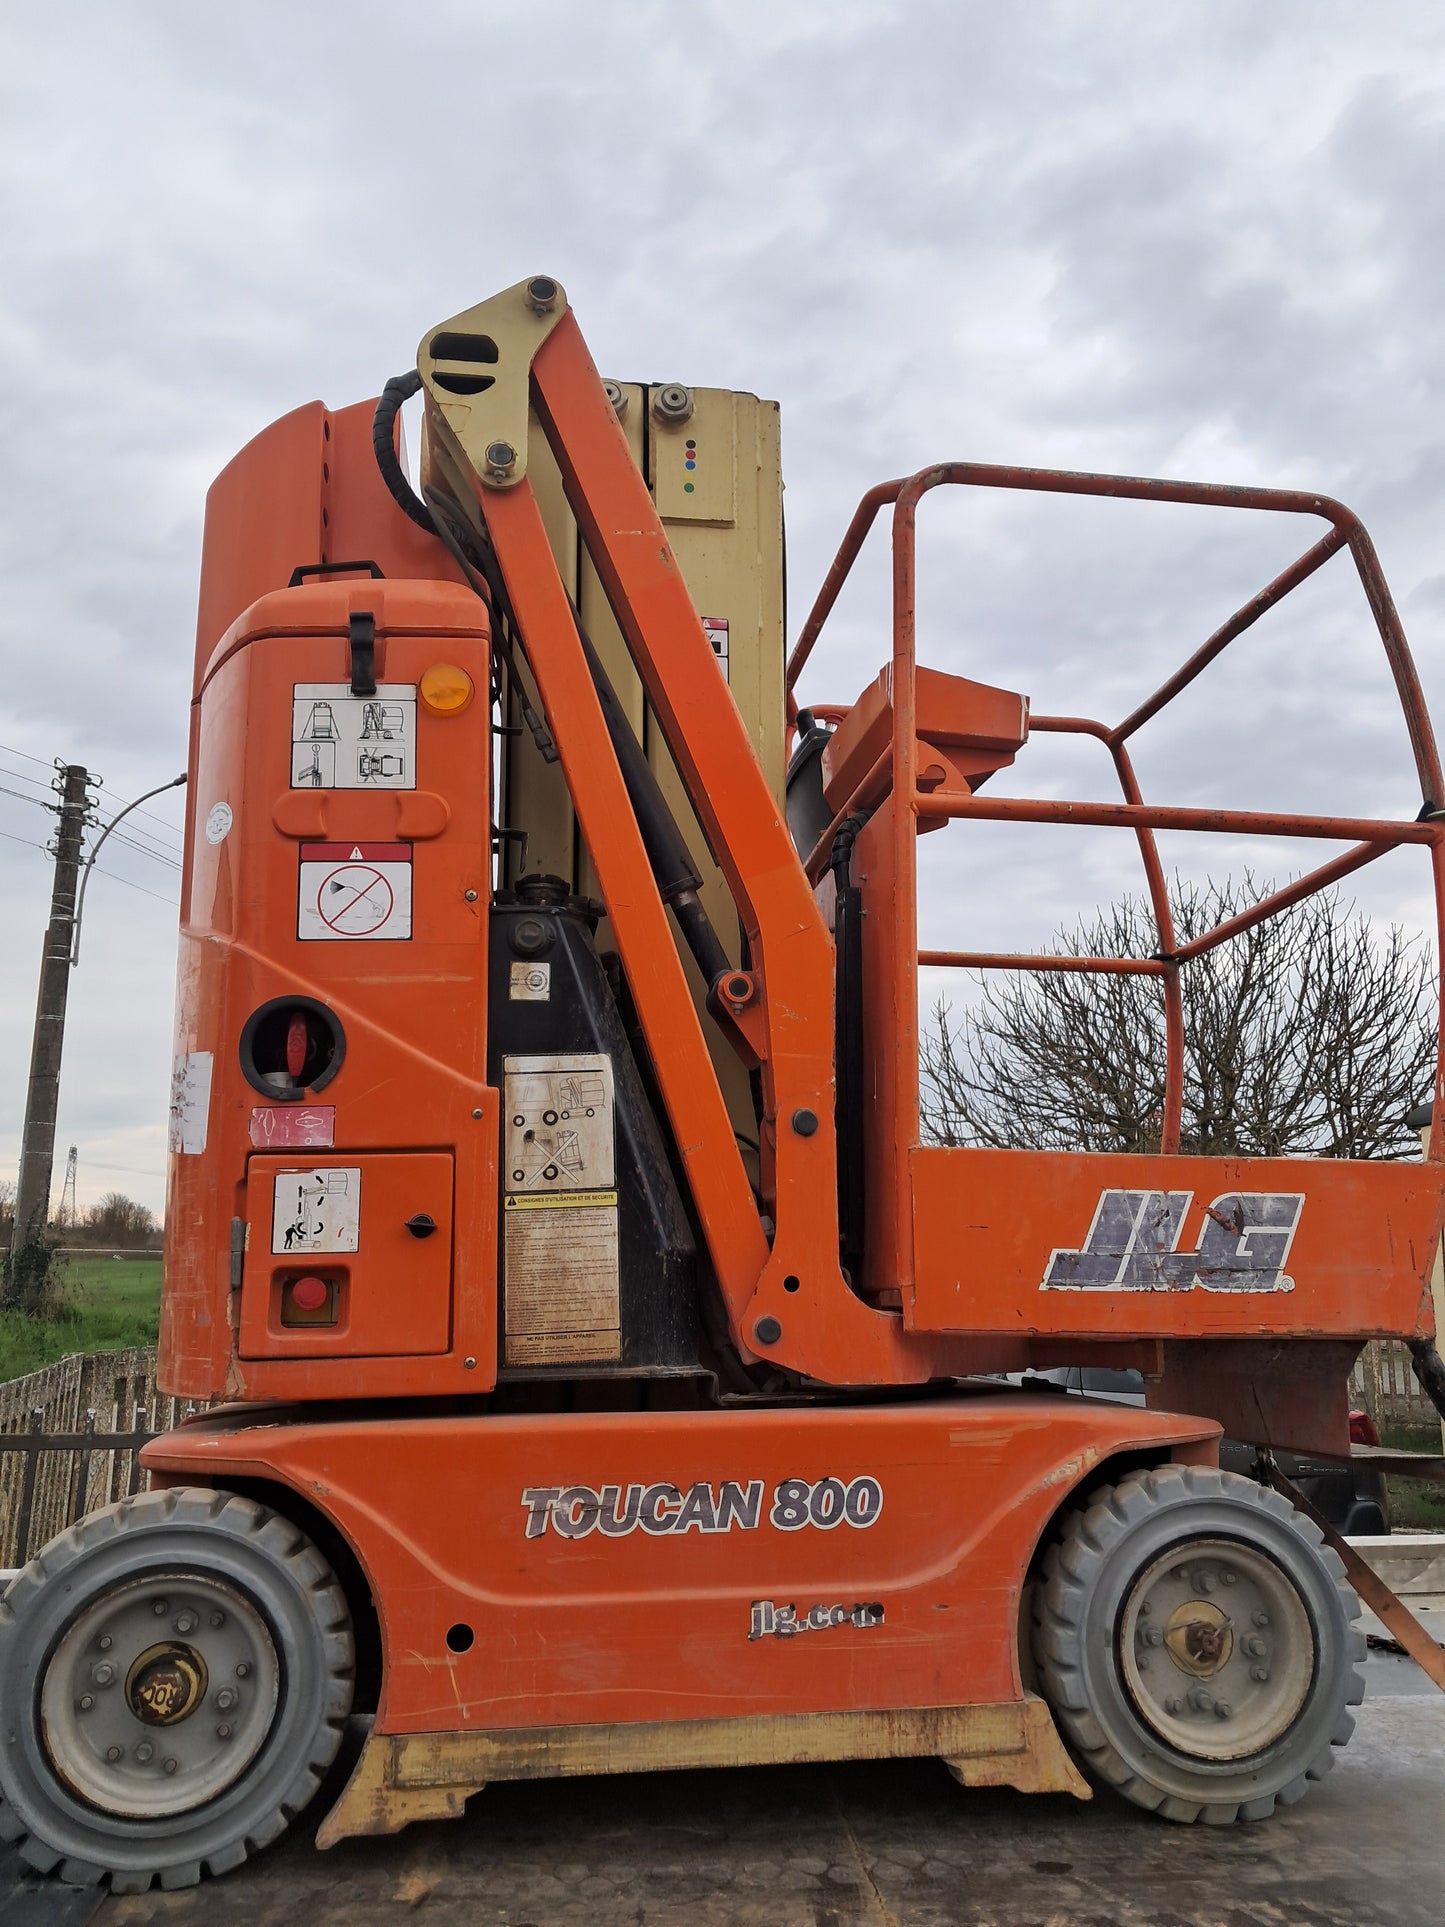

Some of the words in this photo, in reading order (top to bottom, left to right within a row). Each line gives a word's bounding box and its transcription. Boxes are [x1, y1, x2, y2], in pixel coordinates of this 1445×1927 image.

[1038, 1188, 1306, 1293] JLG
[521, 1479, 765, 1540] TOUCAN
[769, 1475, 884, 1532] 800
